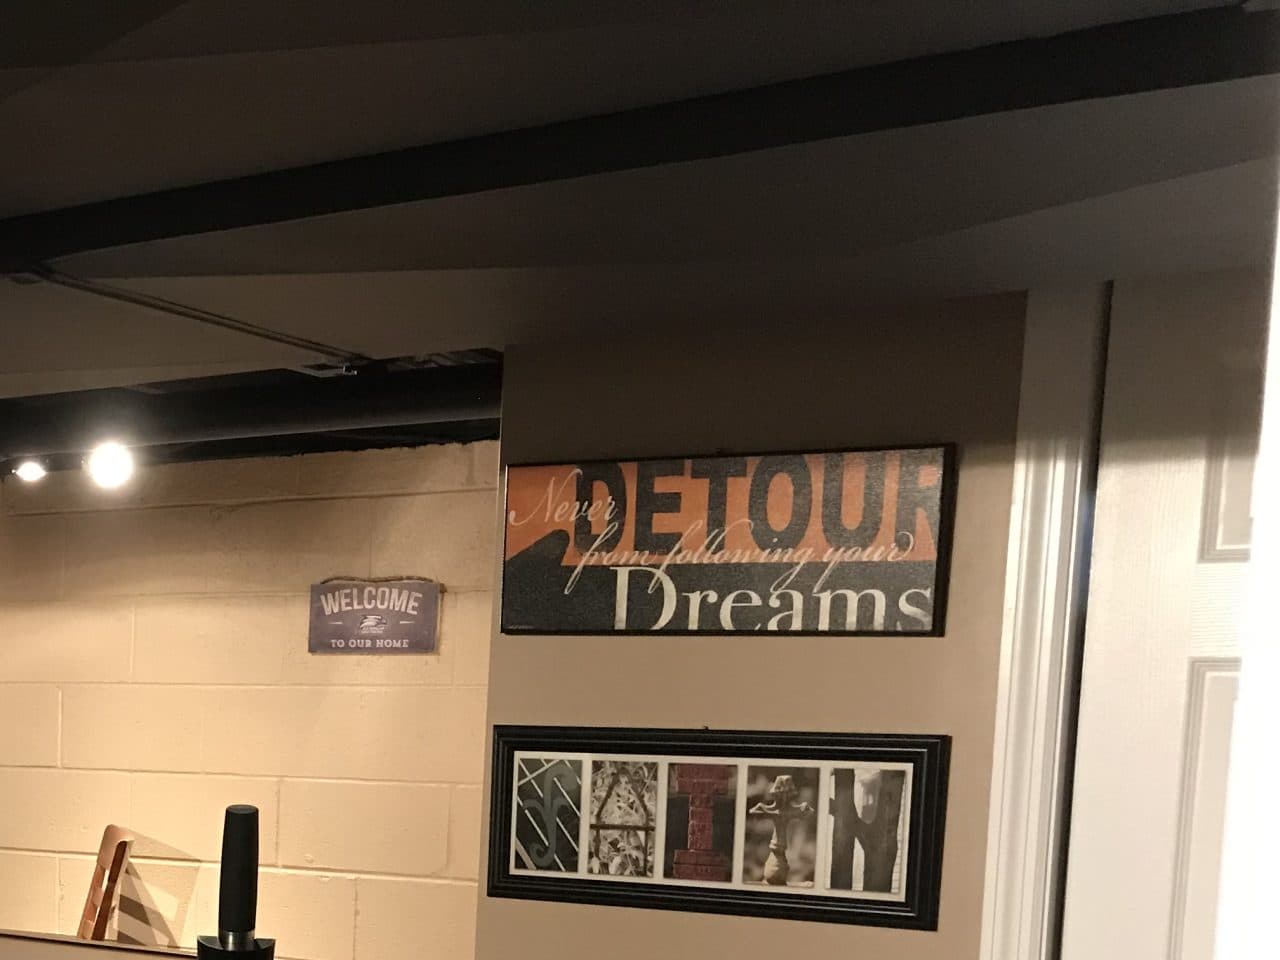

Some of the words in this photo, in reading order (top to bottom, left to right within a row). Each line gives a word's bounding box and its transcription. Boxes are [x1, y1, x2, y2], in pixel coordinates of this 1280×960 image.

[508, 468, 618, 526] Never
[574, 448, 943, 557] DETOUR
[564, 522, 657, 595] from
[647, 519, 817, 594] following
[813, 531, 914, 594] your
[320, 587, 423, 615] WELCOME
[610, 565, 932, 631] Dreams
[330, 639, 345, 648] TO
[348, 639, 371, 648] OUR
[376, 639, 409, 648] HOME
